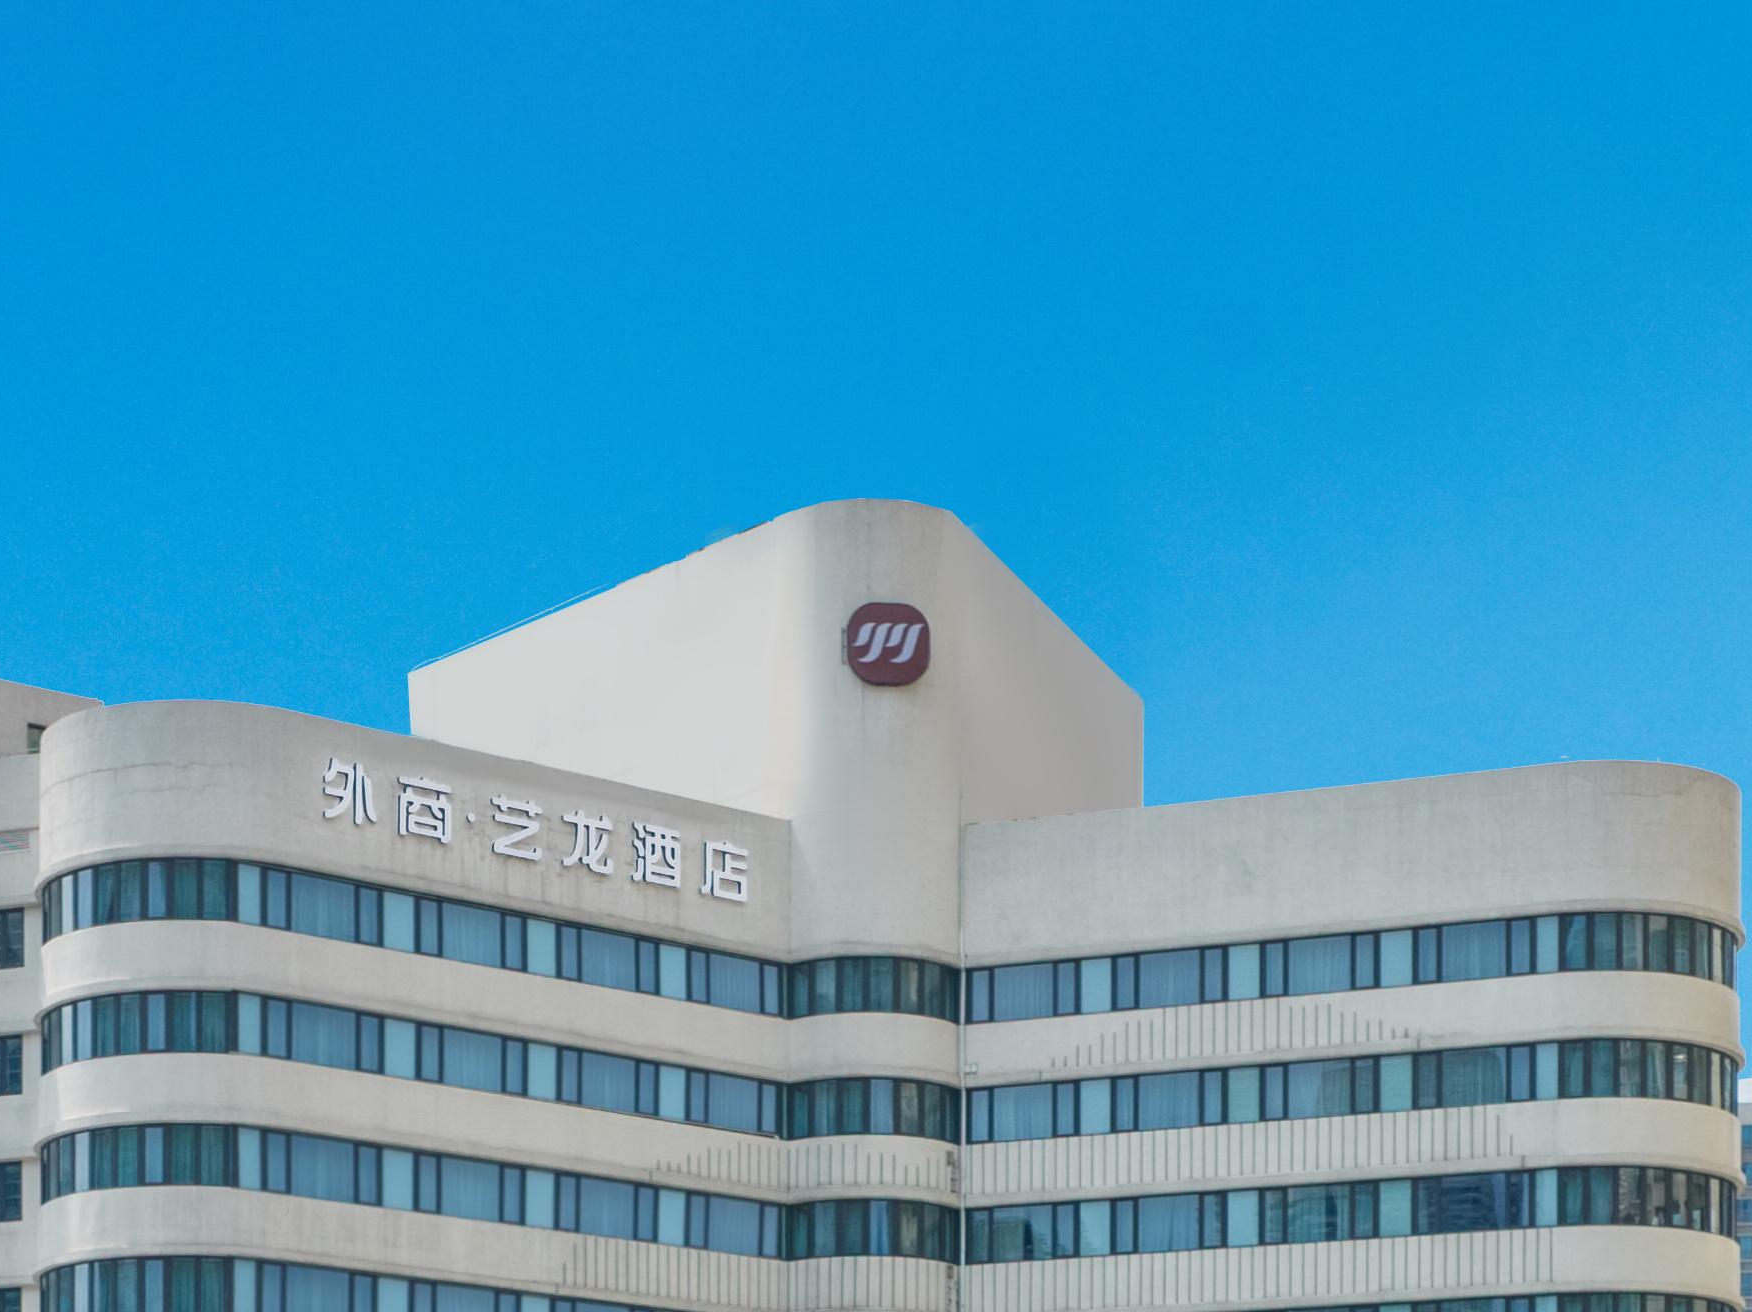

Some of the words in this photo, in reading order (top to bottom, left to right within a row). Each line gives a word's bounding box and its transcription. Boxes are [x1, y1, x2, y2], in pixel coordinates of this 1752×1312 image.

[323, 757, 749, 902] 外商·艺龙酒店
